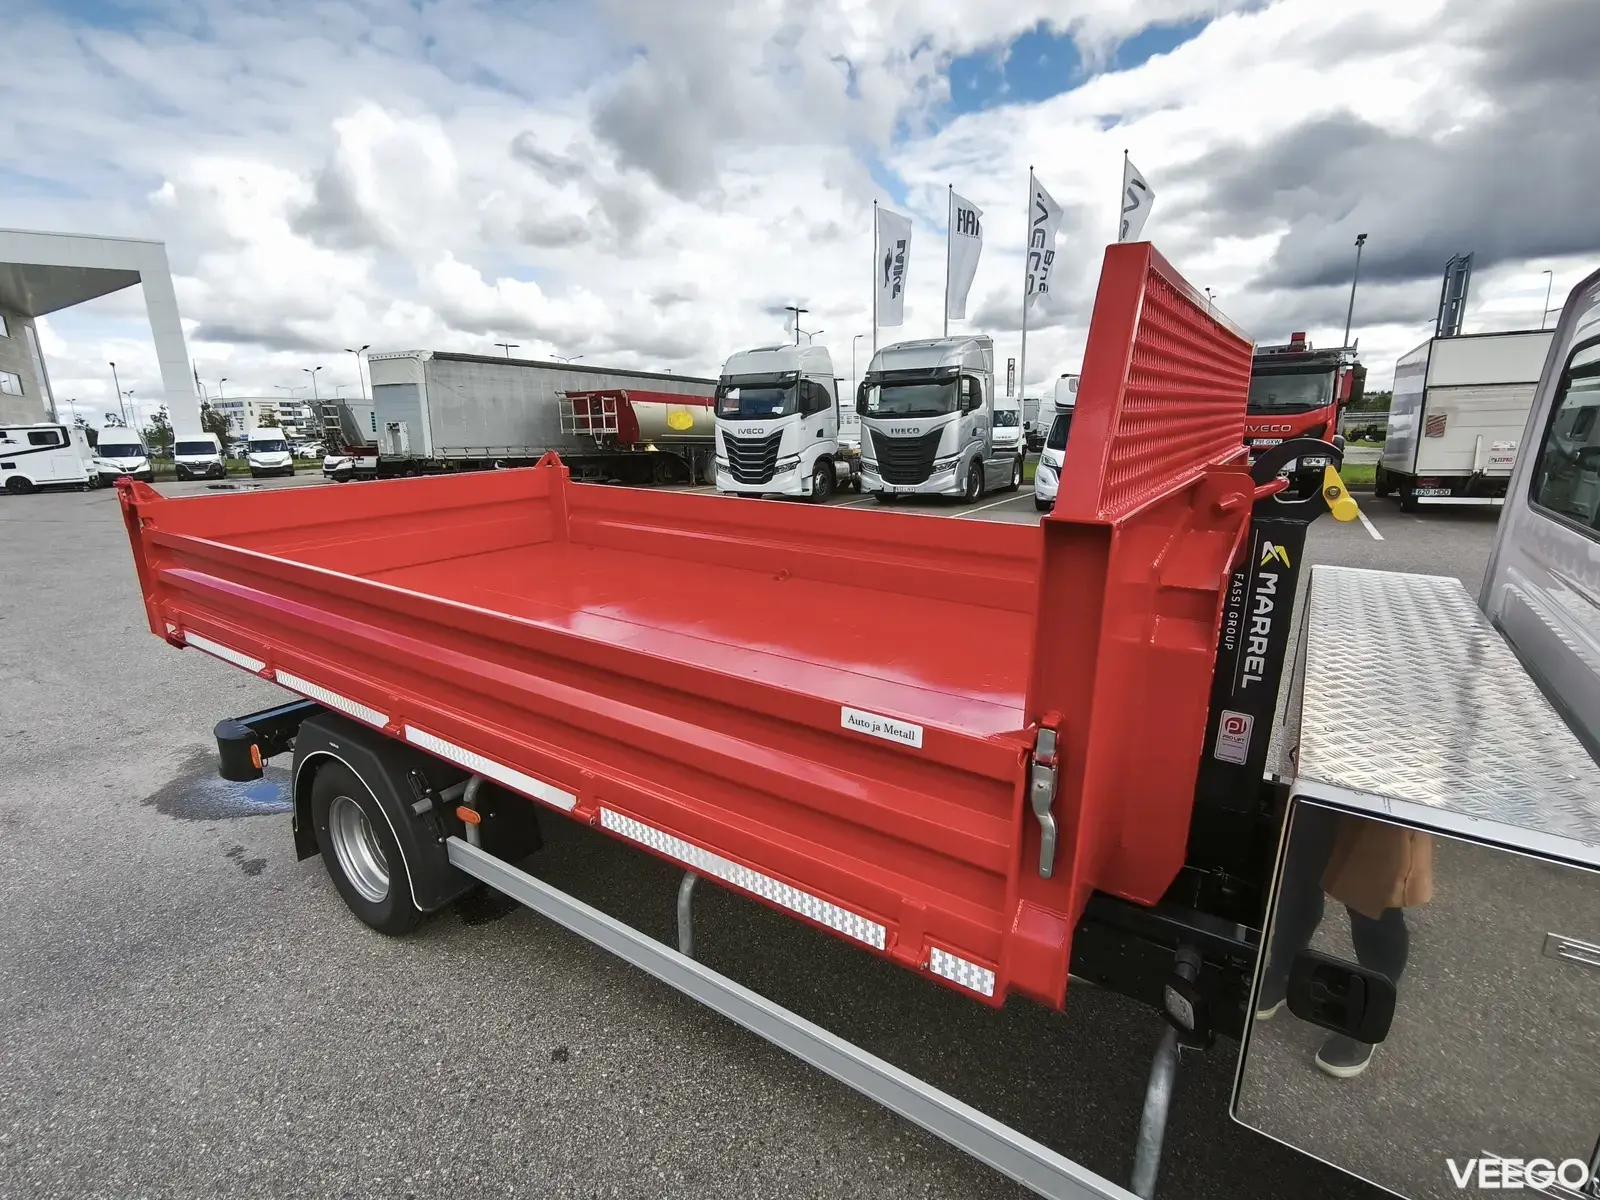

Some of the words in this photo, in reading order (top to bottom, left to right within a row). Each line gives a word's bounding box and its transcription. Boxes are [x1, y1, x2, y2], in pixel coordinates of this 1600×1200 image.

[890, 427, 920, 435] IVECO
[1245, 424, 1292, 432] IVECO
[1231, 573, 1244, 608] FASSI
[1224, 610, 1238, 650] GROUP
[1241, 572, 1278, 689] MARREL
[847, 714, 870, 728] Auto
[871, 721, 881, 733] ja
[883, 723, 915, 741] Metall
